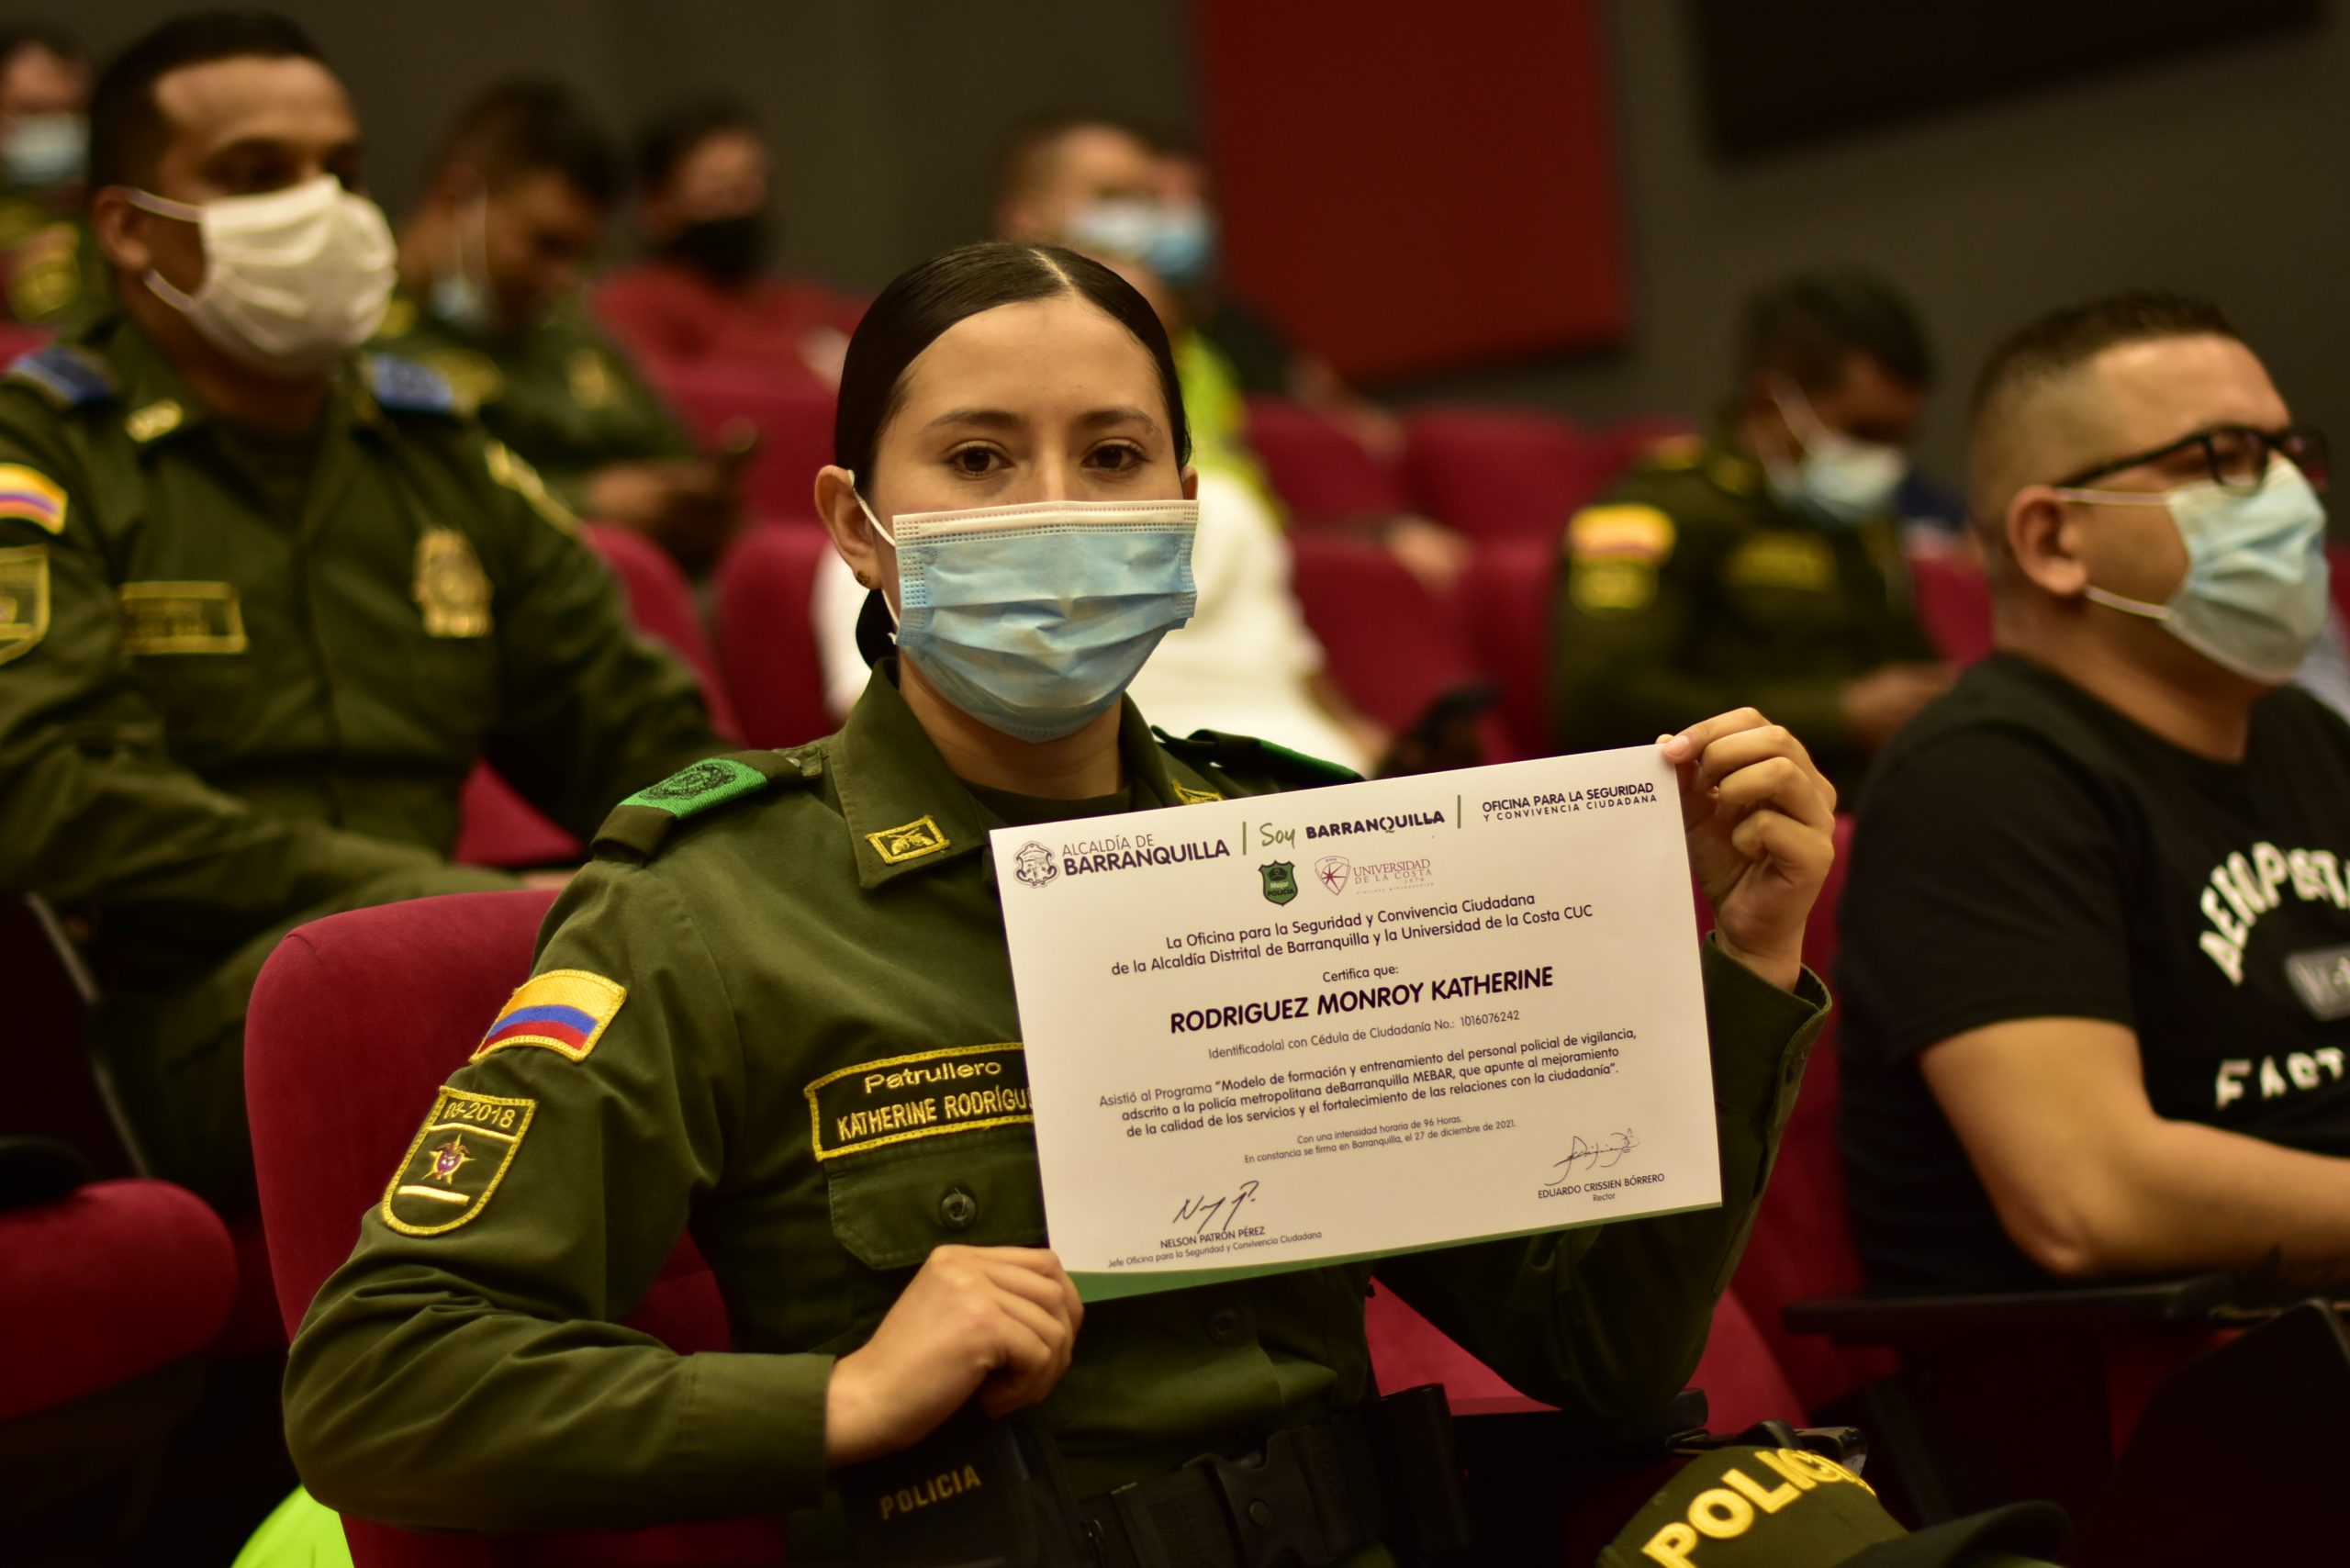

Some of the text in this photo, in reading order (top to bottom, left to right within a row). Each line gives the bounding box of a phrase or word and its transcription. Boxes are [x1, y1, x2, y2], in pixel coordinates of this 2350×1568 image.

[1482, 782, 1654, 812] OFICINA PARA LA SEGURIDAD
[1483, 793, 1657, 822] Y CONVIVENCIA CIUDADANA
[1259, 822, 1295, 849] Soy
[1305, 810, 1445, 839] BARRANQUILLA
[1062, 833, 1155, 857] ALCALDÍA DE
[1063, 839, 1230, 876] BARRANQUILLA
[1353, 858, 1431, 878] UNIVERSIDAD
[1355, 868, 1432, 886] DE LA COSTA
[1270, 881, 1289, 890] Mejor
[1166, 894, 1535, 949] La Oficina para la Seguridad y Convivencia Ciudadana
[1111, 903, 1593, 976] de la Alcaldía Distrital de Barranquilla y la Universidad de la Costa CUC
[1322, 966, 1399, 982] Certifica que:
[1170, 966, 1553, 1034] RODRIGUEZ MONROY KATHERINE
[1208, 1038, 1284, 1058] Identificado(a)
[1287, 1038, 1308, 1049] con
[1310, 1031, 1349, 1046] Cédula
[1352, 1029, 1367, 1041] de
[1369, 1021, 1431, 1038] Ciudadanía
[1460, 1009, 1520, 1026] 1016076242
[865, 1061, 1002, 1093] Patrullero
[1099, 1092, 1137, 1106] Asistió
[1140, 1089, 1151, 1102] al
[1154, 1084, 1213, 1101] Programa
[1269, 1072, 1284, 1085] de
[1287, 1065, 1347, 1082] formación
[1349, 1066, 1356, 1078] y
[1360, 1053, 1443, 1073] entrenamiento
[1446, 1048, 1464, 1062] del
[1467, 1041, 1517, 1062] personal
[1520, 1036, 1560, 1055] policial
[1562, 1035, 1578, 1047] de
[1580, 1027, 1637, 1047] vigilancia,
[1121, 1047, 1619, 1121] adscrito a la policía metropolitana deBarranquilla MEBAR, que apunte al mejoramiento
[836, 1098, 938, 1141] KATHERINE
[1126, 1125, 1142, 1137] de
[1145, 1123, 1157, 1135] la
[1159, 1115, 1204, 1133] calidad
[1207, 1114, 1223, 1126] de
[1225, 1113, 1243, 1124] los
[1246, 1106, 1296, 1122] servicios
[1298, 1105, 1305, 1117] y
[1308, 1101, 1319, 1114] el
[1322, 1092, 1408, 1112] fortalecimiento
[1411, 1087, 1427, 1100] de
[1429, 1085, 1447, 1097] las
[1449, 1079, 1507, 1094] relaciones
[1510, 1076, 1531, 1087] con
[1533, 1071, 1545, 1083] la
[1244, 1154, 1255, 1163] En
[1256, 1148, 1302, 1162] constancia
[1303, 1148, 1314, 1156] se
[1315, 1144, 1337, 1154] firma
[1338, 1142, 1350, 1151] en
[1404, 1132, 1413, 1142] el
[1414, 1130, 1425, 1140] 27
[1427, 1129, 1438, 1139] de
[1439, 1125, 1481, 1137] diciembre
[1482, 1122, 1494, 1131] de
[1296, 1135, 1314, 1144] Con
[1315, 1133, 1333, 1142] una
[1334, 1125, 1378, 1139] intensidad
[1379, 1122, 1409, 1133] horaria
[1410, 1120, 1422, 1129] de
[1423, 1117, 1435, 1126] 96
[1538, 1172, 1665, 1199] EDUARDO CRISSIEN BÓRRERO
[1592, 1193, 1616, 1202] Rector
[1108, 1258, 1125, 1268] Jefe
[1125, 1255, 1154, 1265] Oficina
[1155, 1252, 1174, 1262] para
[1184, 1244, 1225, 1257] Seguridad
[1232, 1237, 1279, 1250] Convivencia
[1279, 1231, 1322, 1244] Ciudadana
[1159, 1236, 1197, 1249] NELSON
[1237, 1226, 1266, 1238] PÉREZ
[879, 1464, 981, 1520] POLICIA
[1640, 1447, 1875, 1568] POLIC
